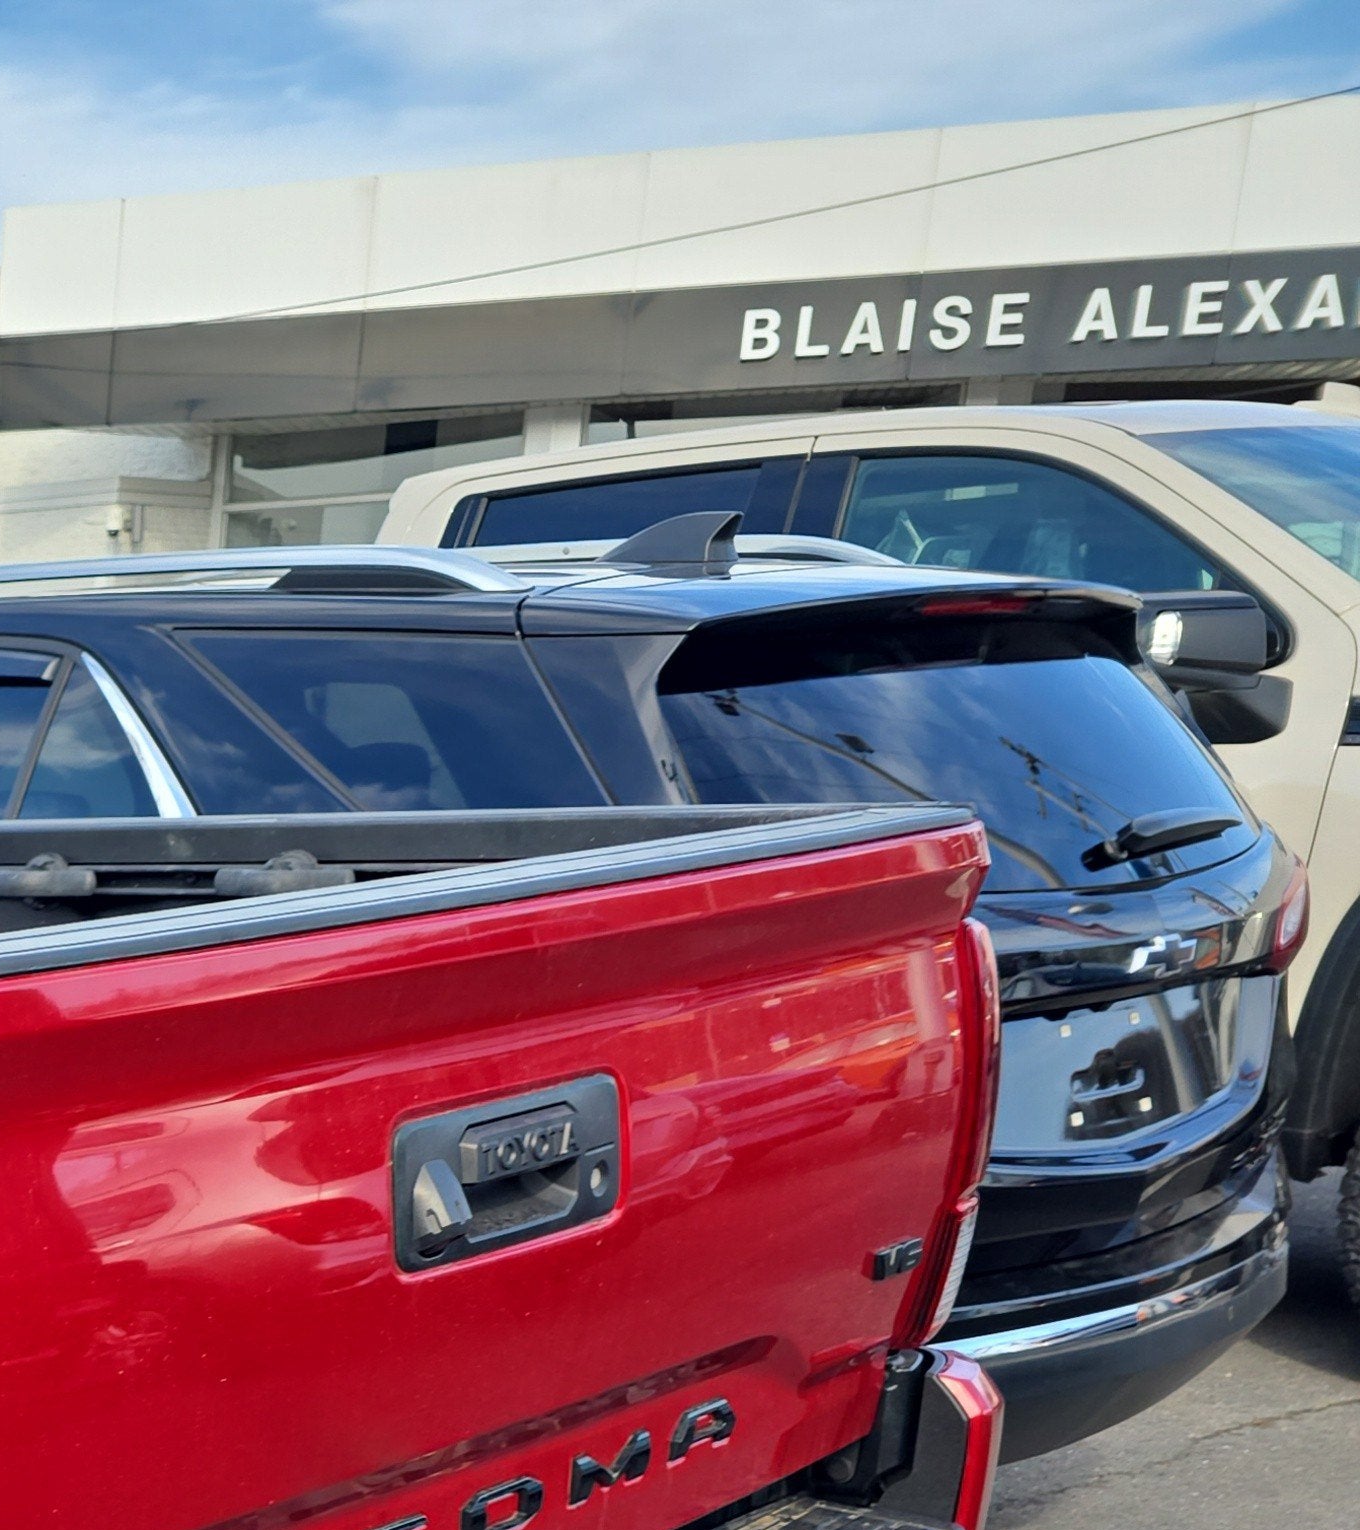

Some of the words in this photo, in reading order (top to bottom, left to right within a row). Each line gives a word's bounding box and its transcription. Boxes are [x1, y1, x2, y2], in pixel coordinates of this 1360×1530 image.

[739, 291, 1031, 362] BLAISE
[1071, 273, 1360, 343] ALEXA
[481, 1122, 579, 1175] TOYOTA
